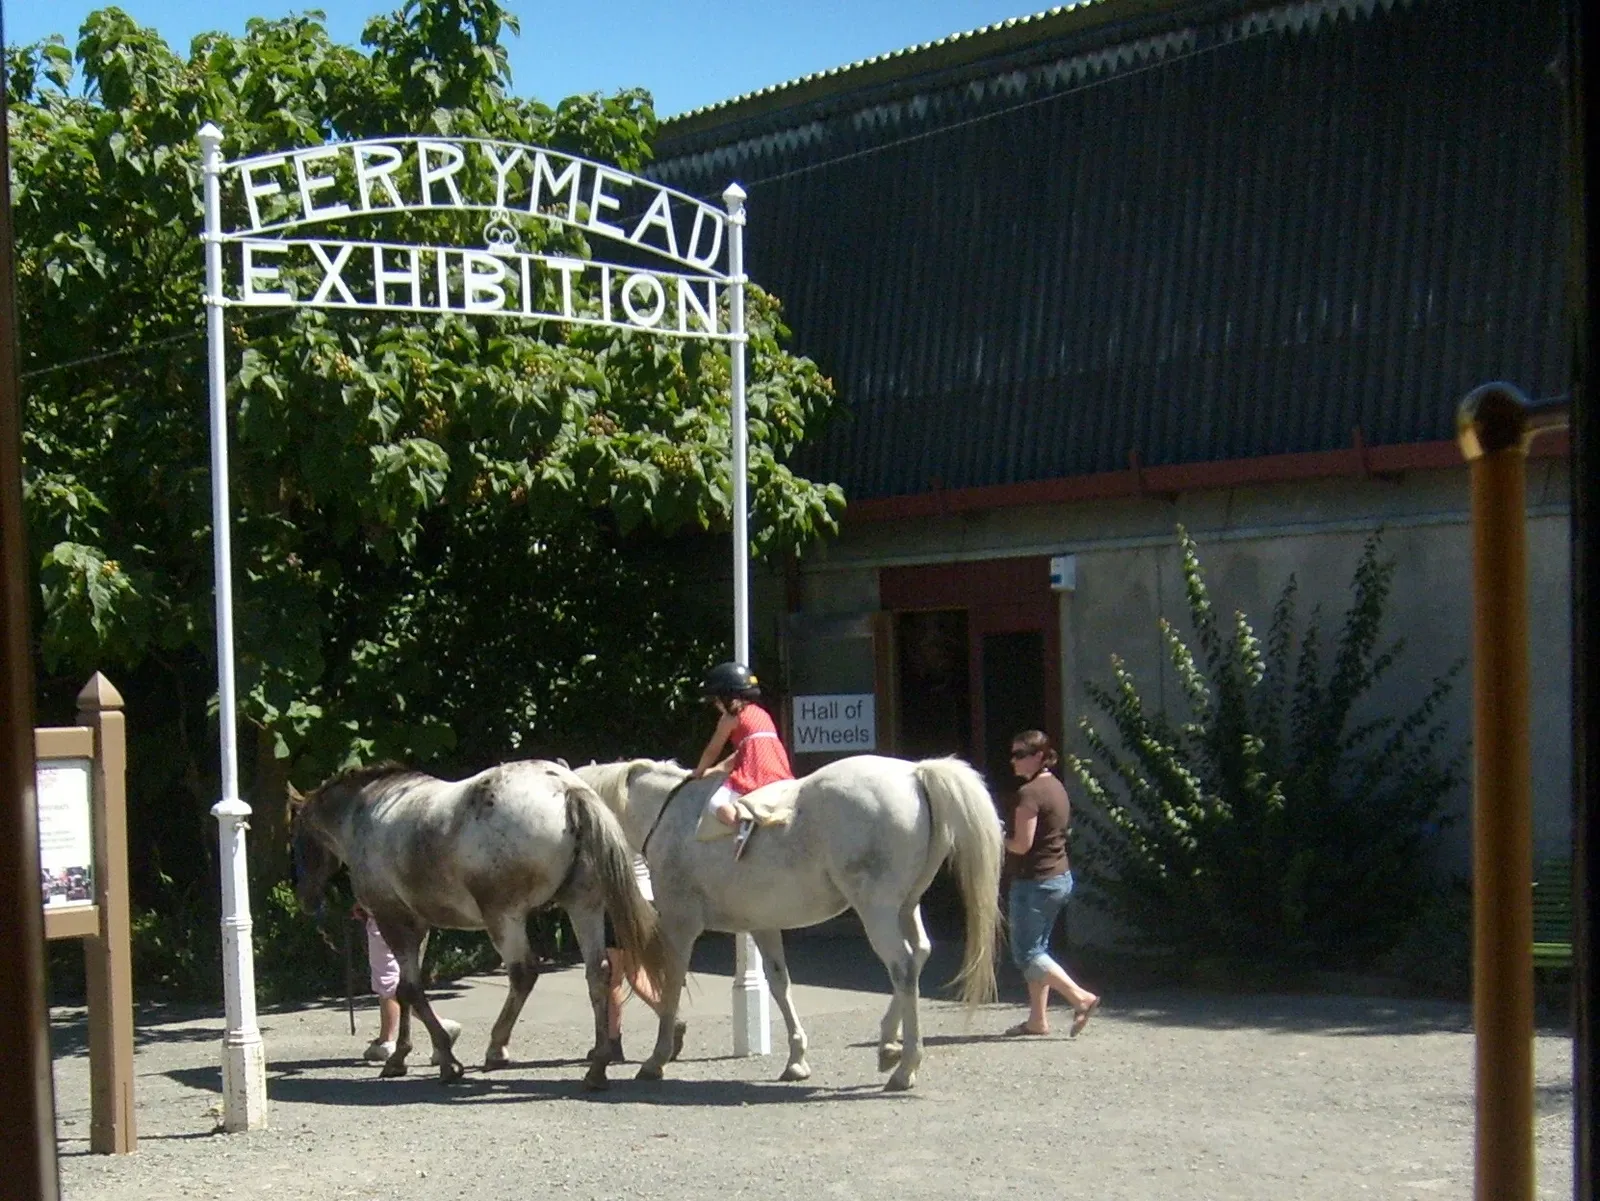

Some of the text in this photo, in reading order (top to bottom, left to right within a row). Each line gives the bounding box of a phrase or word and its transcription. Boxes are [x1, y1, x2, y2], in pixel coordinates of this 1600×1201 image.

[241, 140, 725, 269] FERRYMEAD
[243, 242, 717, 335] EXHIBITION
[797, 725, 869, 744] Wheels
[802, 700, 863, 720] Hall of
